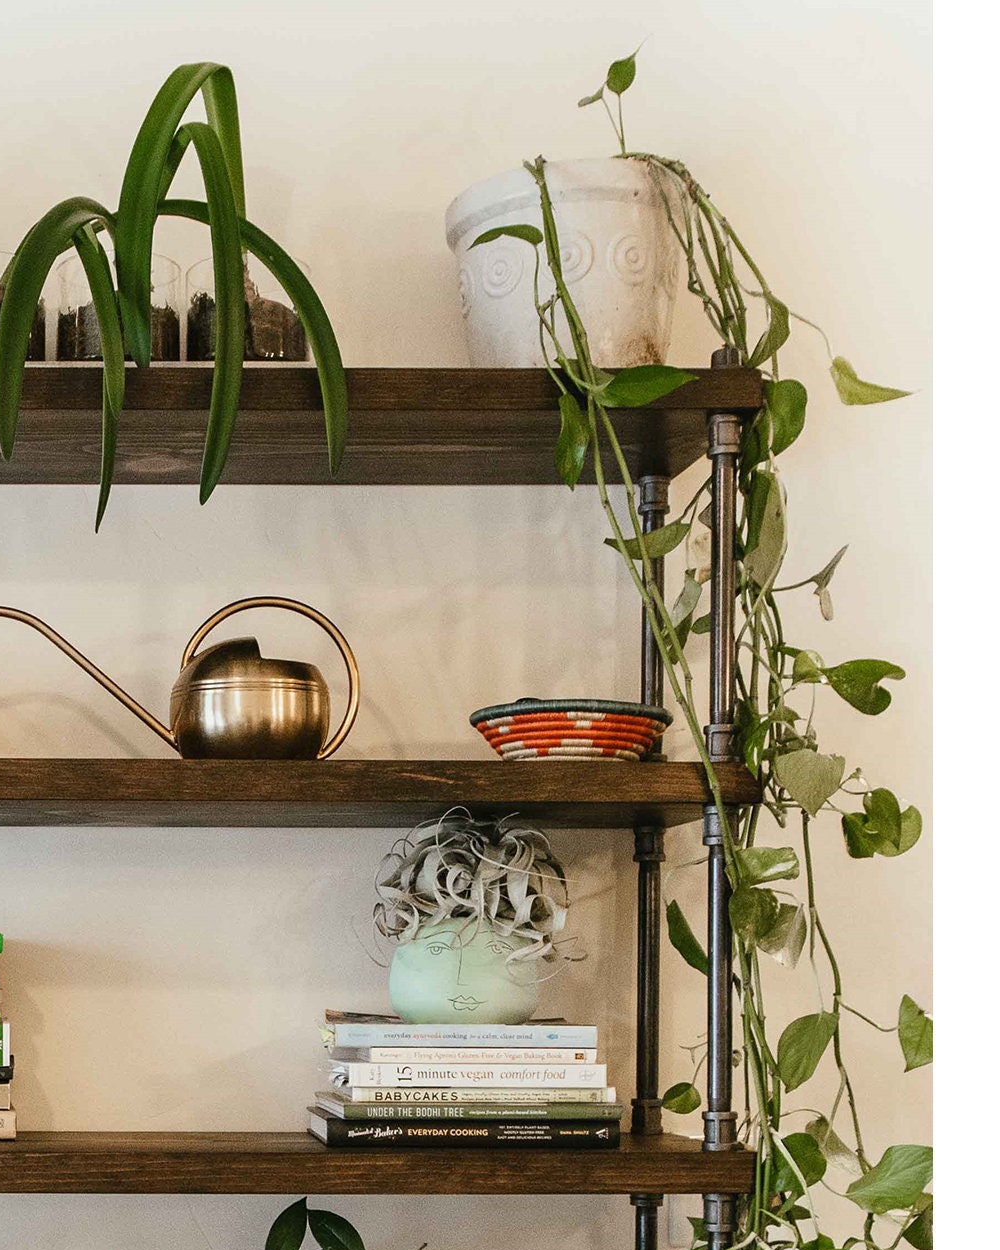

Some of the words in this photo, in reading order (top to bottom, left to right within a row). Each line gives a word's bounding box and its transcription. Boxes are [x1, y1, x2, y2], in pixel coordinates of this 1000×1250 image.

[396, 1066, 412, 1081] 15
[417, 1068, 458, 1078] minute
[460, 1070, 494, 1081] vegan
[500, 1068, 540, 1080] comfort
[542, 1068, 566, 1081] food
[374, 1091, 459, 1100] BABYCAKES
[367, 1108, 394, 1118] UNDER
[398, 1108, 412, 1118] THE
[416, 1108, 440, 1118] BODHI
[444, 1108, 464, 1118] TREE
